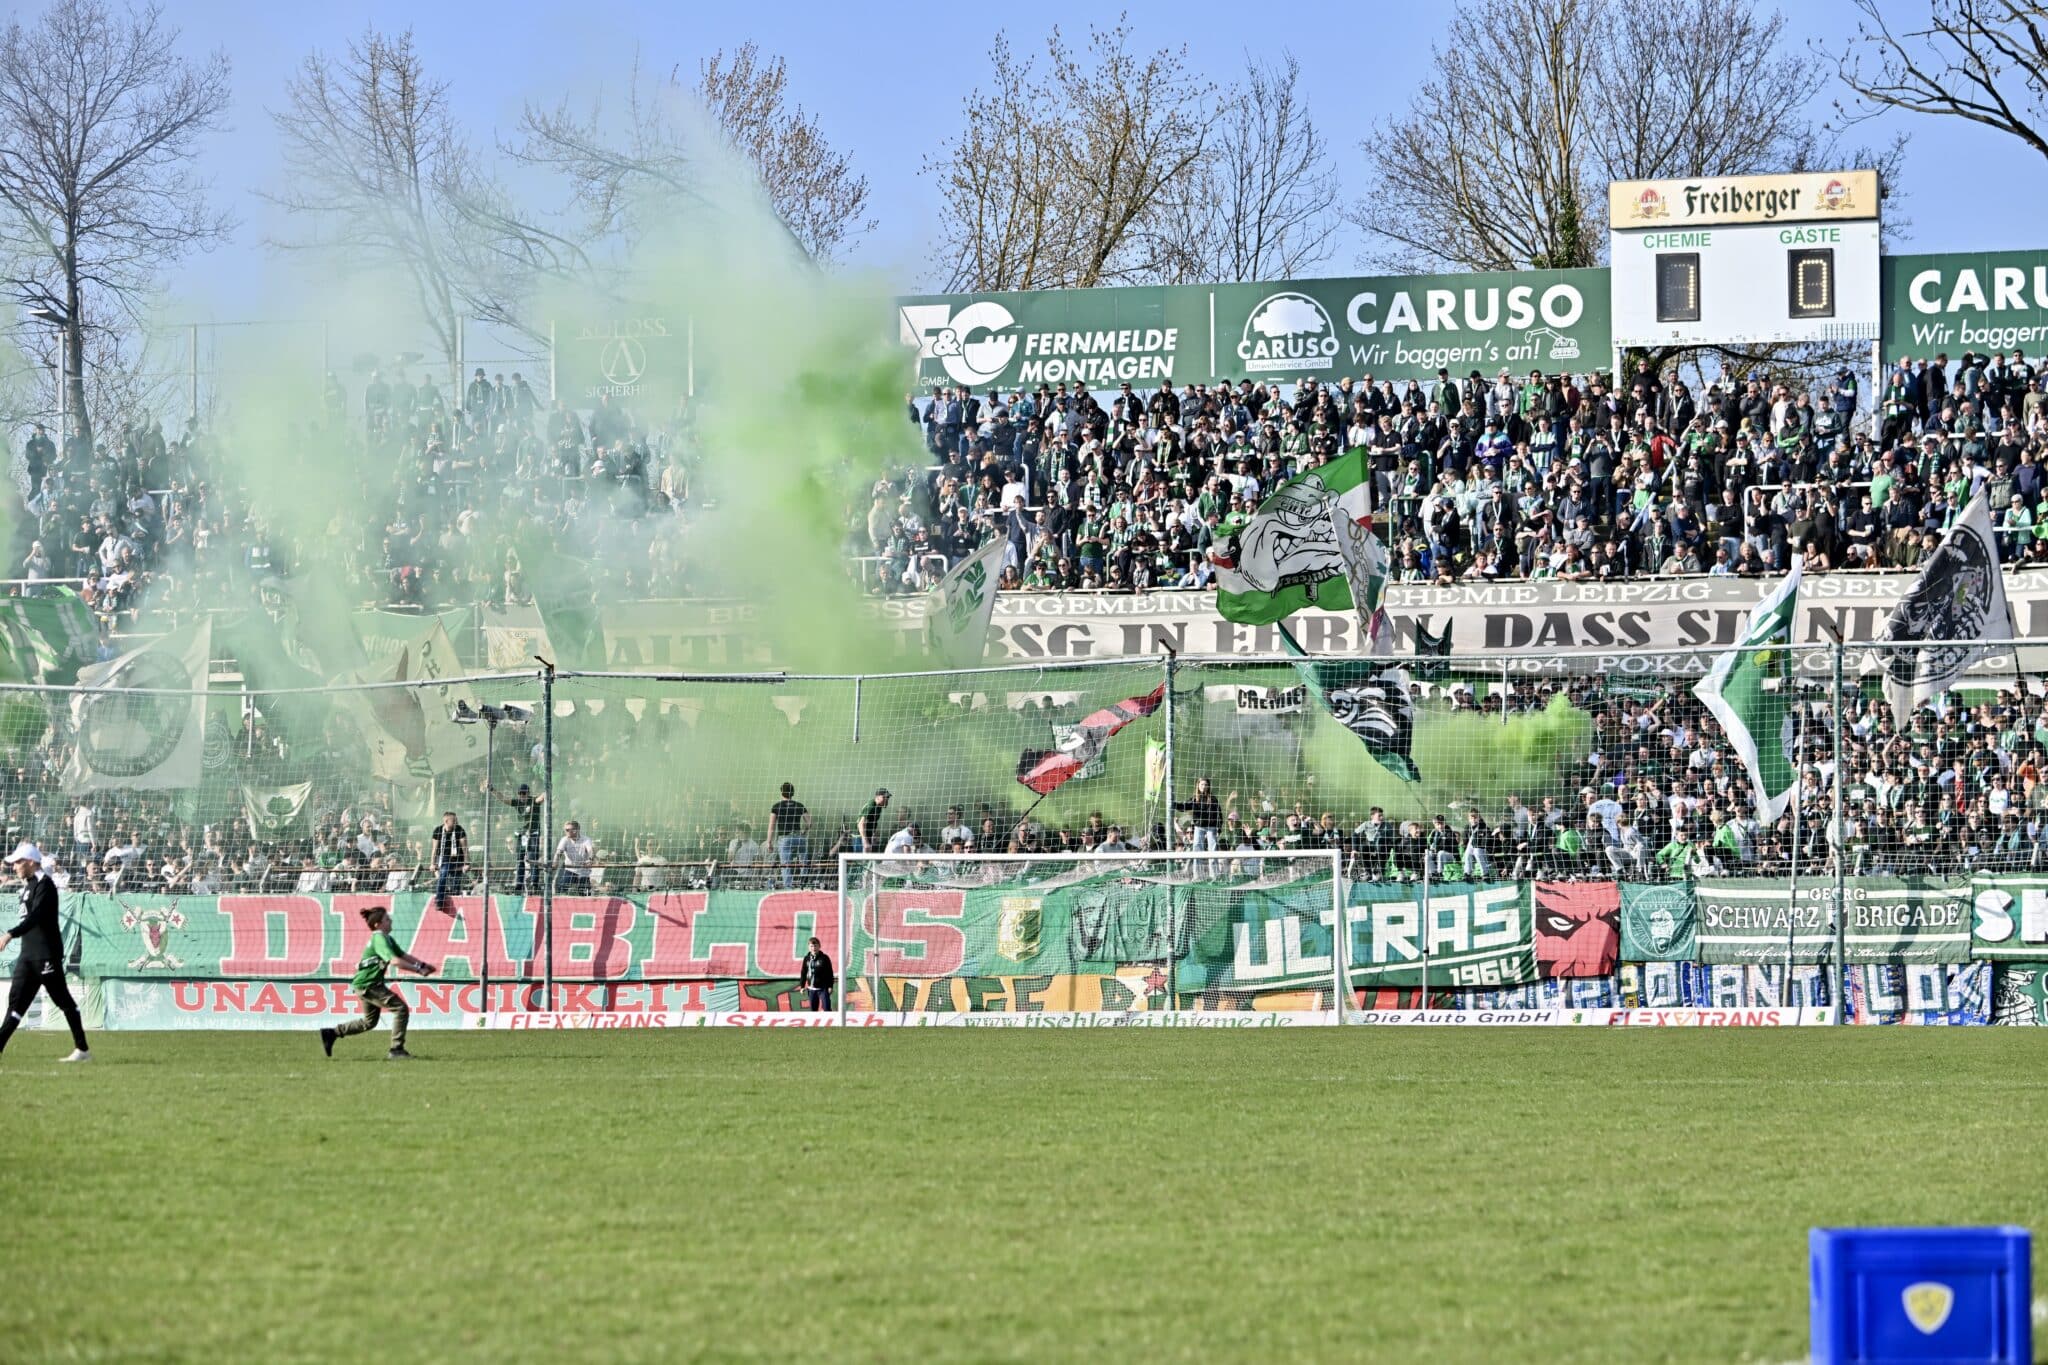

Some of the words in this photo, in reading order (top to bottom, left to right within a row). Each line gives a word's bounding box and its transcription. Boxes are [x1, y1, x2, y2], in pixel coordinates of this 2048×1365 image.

[1683, 184, 1801, 218] Freiberger
[1643, 232, 1712, 249] CHEMIE
[1779, 227, 1841, 245] GÄSTE
[1347, 284, 1584, 335] CARUSO
[1023, 328, 1178, 356] FERNMELDE
[1237, 336, 1340, 360] CARUSO
[1912, 323, 1955, 346] Wir
[1304, 359, 1330, 368] GmbH
[1349, 342, 1393, 366] Wir
[1395, 339, 1498, 370] baggern's
[1506, 338, 1540, 361] an!
[919, 376, 950, 386] GMBH
[1018, 355, 1175, 383] MONTAGEN
[1553, 577, 1712, 604] LEIPZIG
[1118, 622, 1189, 656] IN
[1482, 610, 1653, 650] DASS
[1677, 608, 1752, 646] SI
[1705, 903, 1820, 929] SCHWARZ
[1855, 902, 1960, 928] BRIGADE
[218, 889, 967, 979] DIABLOS
[1234, 886, 1521, 980] ULTRAS
[1449, 956, 1521, 986] 1964
[1364, 1012, 1402, 1024] Die
[1411, 1012, 1468, 1024] Auto
[1478, 1012, 1551, 1024] GmbH
